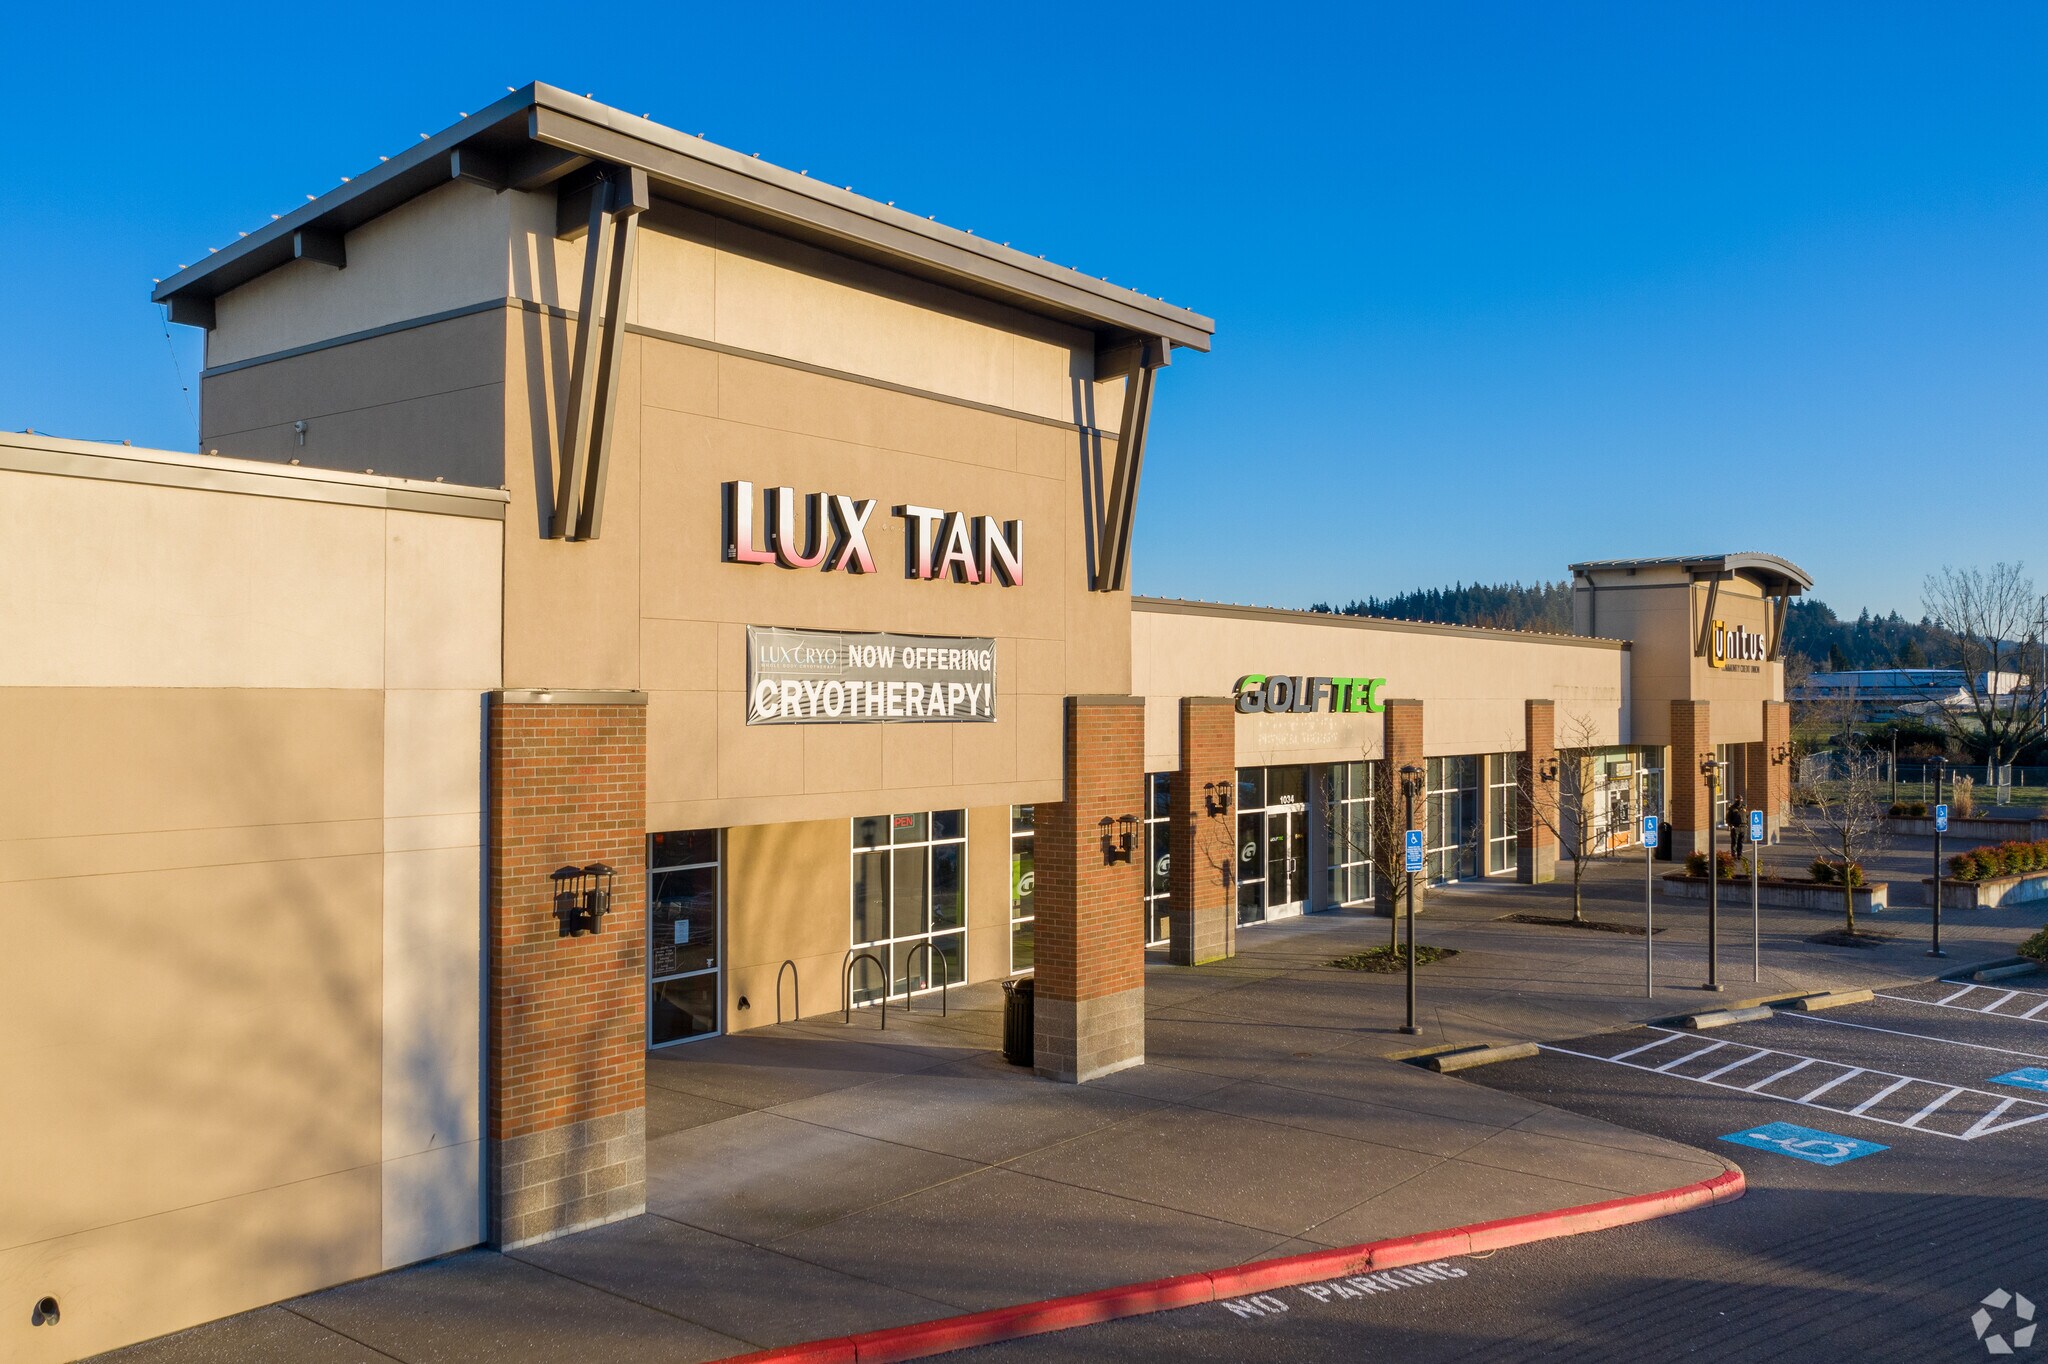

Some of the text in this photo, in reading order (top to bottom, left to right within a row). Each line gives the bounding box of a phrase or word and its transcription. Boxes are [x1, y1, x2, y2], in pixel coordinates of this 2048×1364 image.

[722, 480, 1024, 587] LUX TAN
[761, 641, 837, 665] LUX CRYO
[849, 644, 991, 671] NOW OFFERING
[755, 678, 991, 718] CRYOTHERAPY!
[1234, 674, 1387, 713] GOLFTEC
[1280, 795, 1295, 804] 1034
[893, 816, 913, 828] PEN
[1222, 1262, 1468, 1319] NO PARKING
